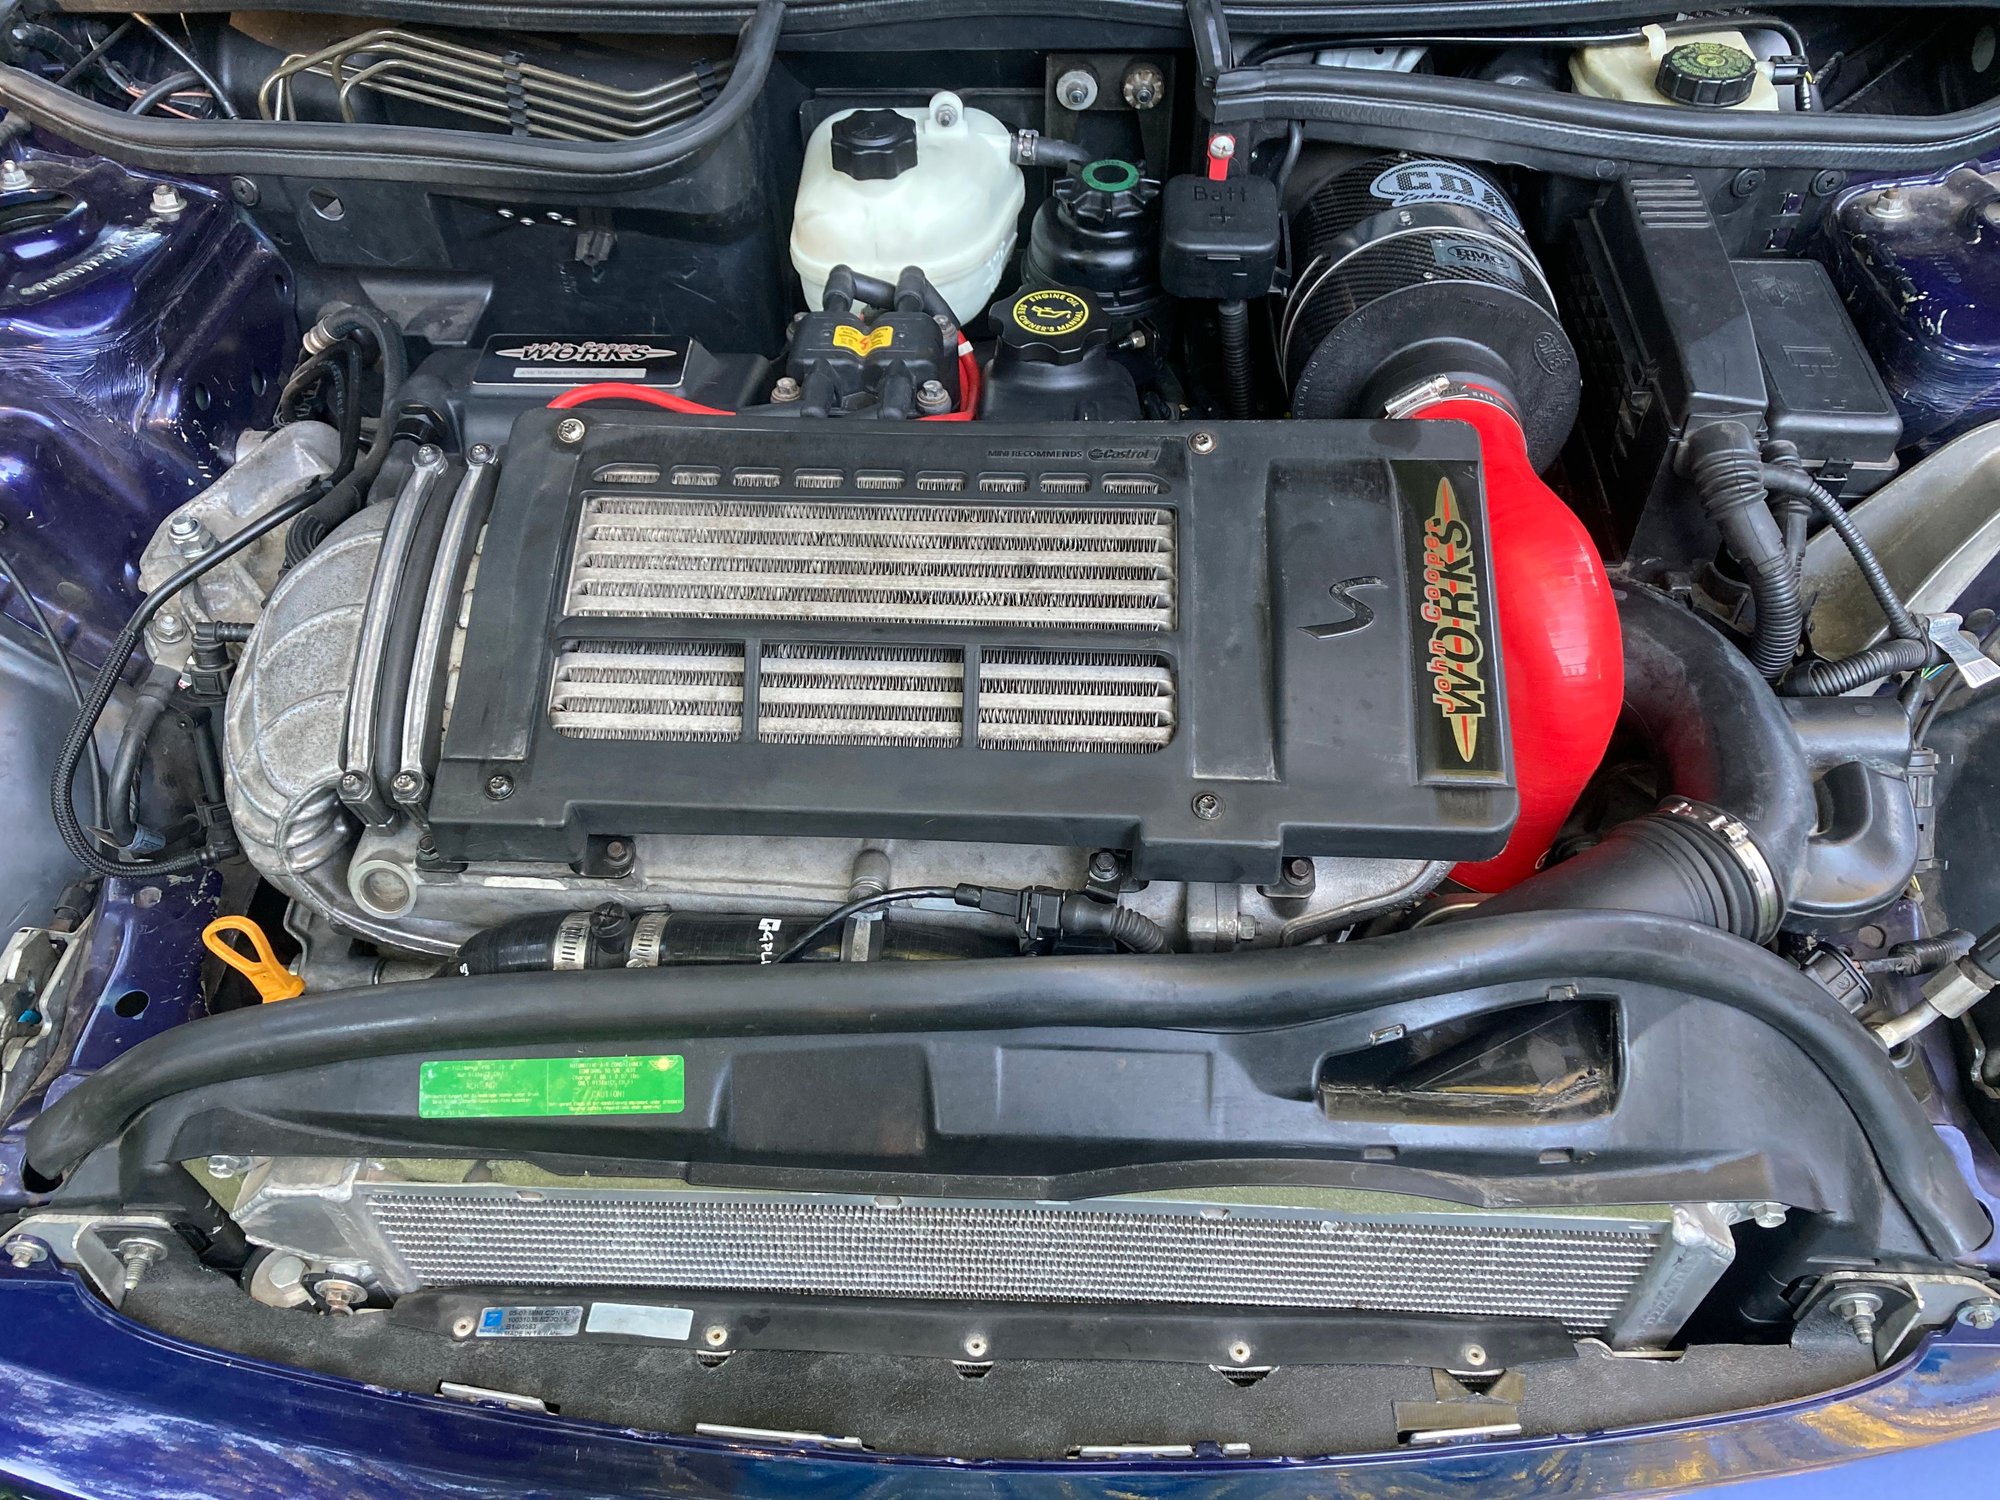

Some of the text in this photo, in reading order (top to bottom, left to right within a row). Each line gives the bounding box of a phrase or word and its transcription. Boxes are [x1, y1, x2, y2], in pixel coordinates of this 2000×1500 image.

[1399, 192, 1451, 203] Carbon
[1029, 293, 1079, 307] ENGINE OIL
[1018, 304, 1084, 332] SEE OWNER'S MANUAL
[520, 345, 651, 362] WORKS
[526, 341, 651, 351] John Cooper
[987, 448, 1150, 460] MINI RECOMMENDS Castrol
[1296, 575, 1389, 640] S
[1422, 518, 1456, 713] John Cooper
[1437, 519, 1484, 716] WORKS
